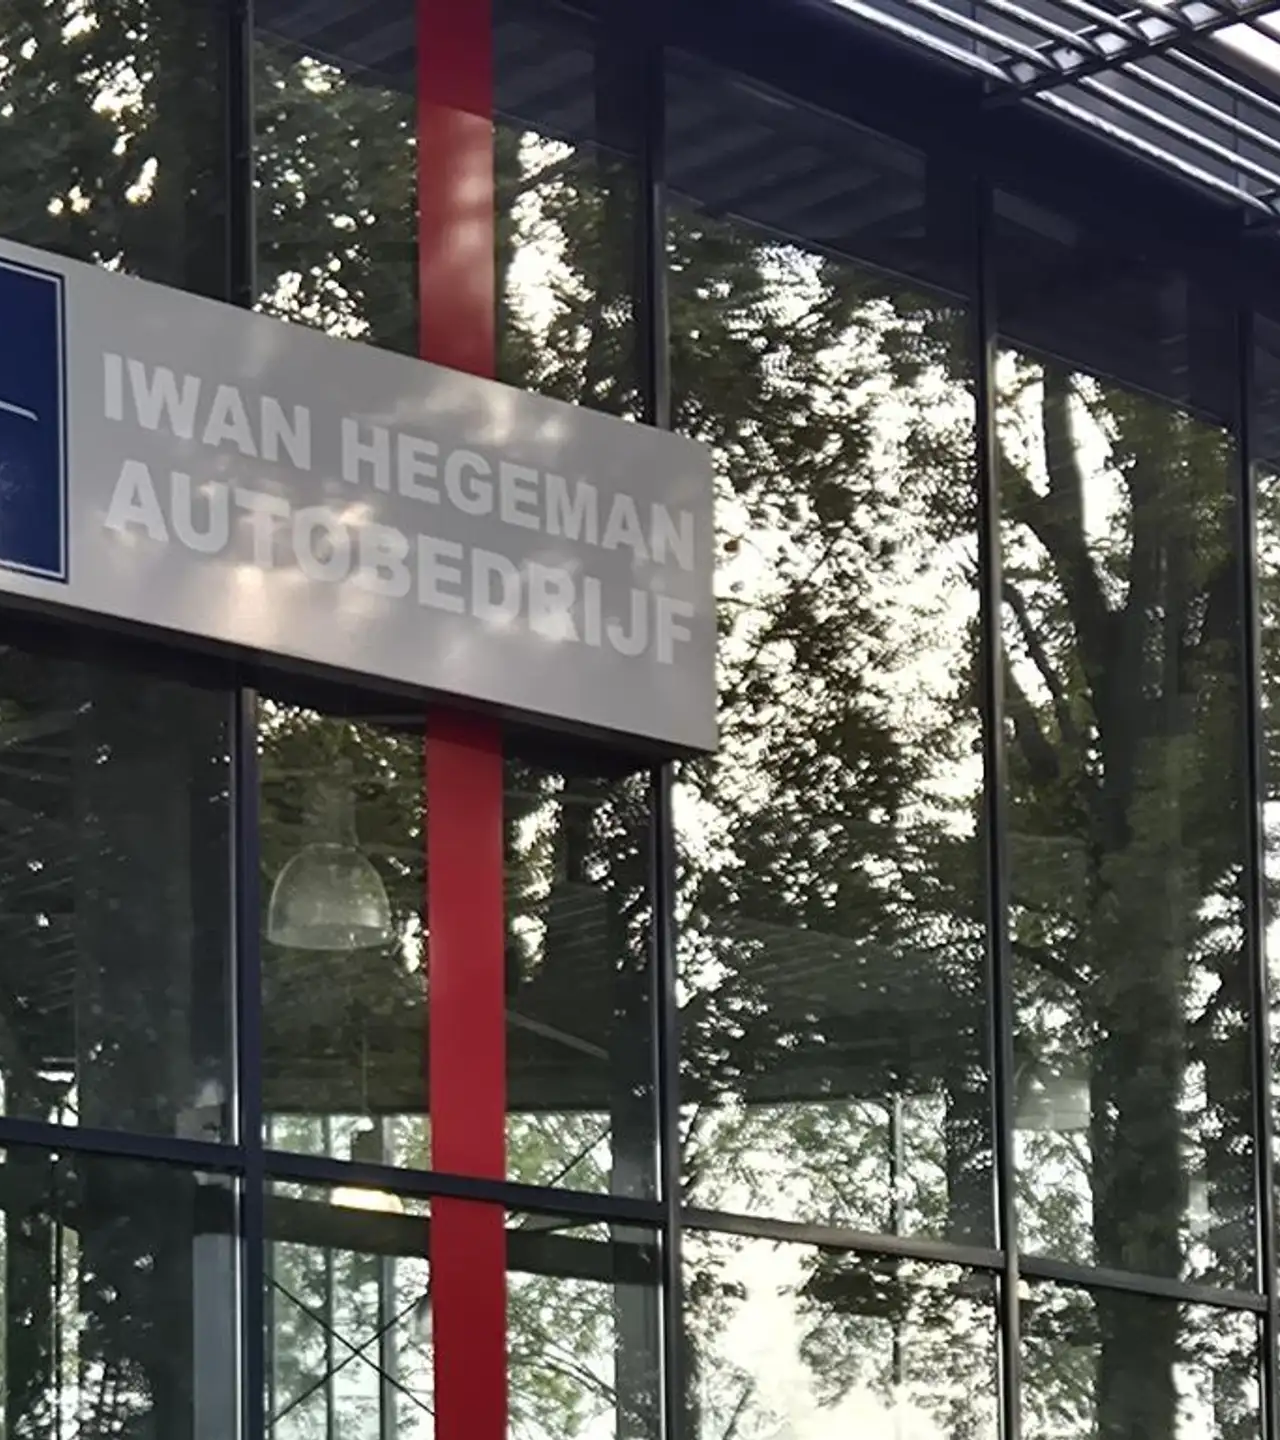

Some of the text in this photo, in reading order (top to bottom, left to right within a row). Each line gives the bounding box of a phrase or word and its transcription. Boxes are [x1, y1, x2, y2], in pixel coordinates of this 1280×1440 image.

[102, 352, 696, 572] IWAN HEGEMAN
[104, 458, 696, 665] AUTOBEDRIJF
